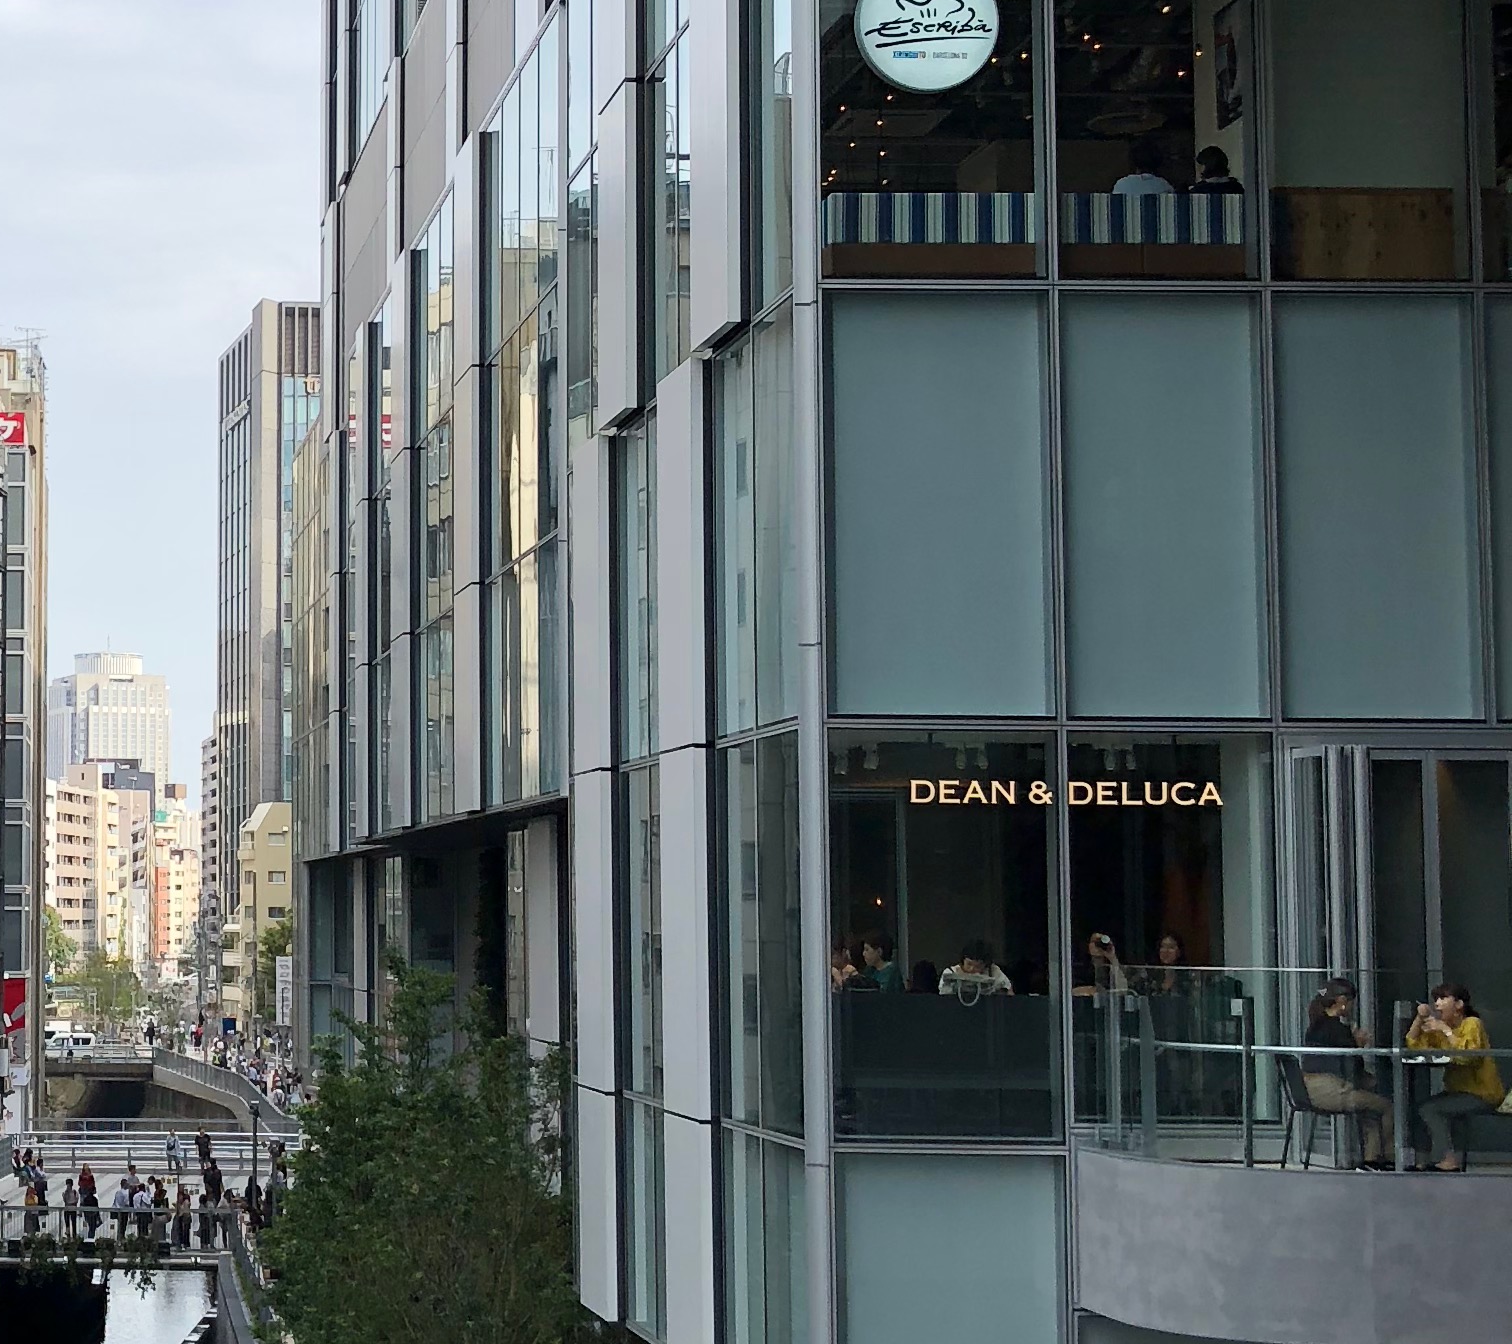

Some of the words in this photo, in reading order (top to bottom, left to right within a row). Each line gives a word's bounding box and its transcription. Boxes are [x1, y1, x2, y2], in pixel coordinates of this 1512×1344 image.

[909, 779, 1016, 805] DEAN
[1028, 780, 1053, 805] &
[1067, 780, 1224, 806] DELUCA
